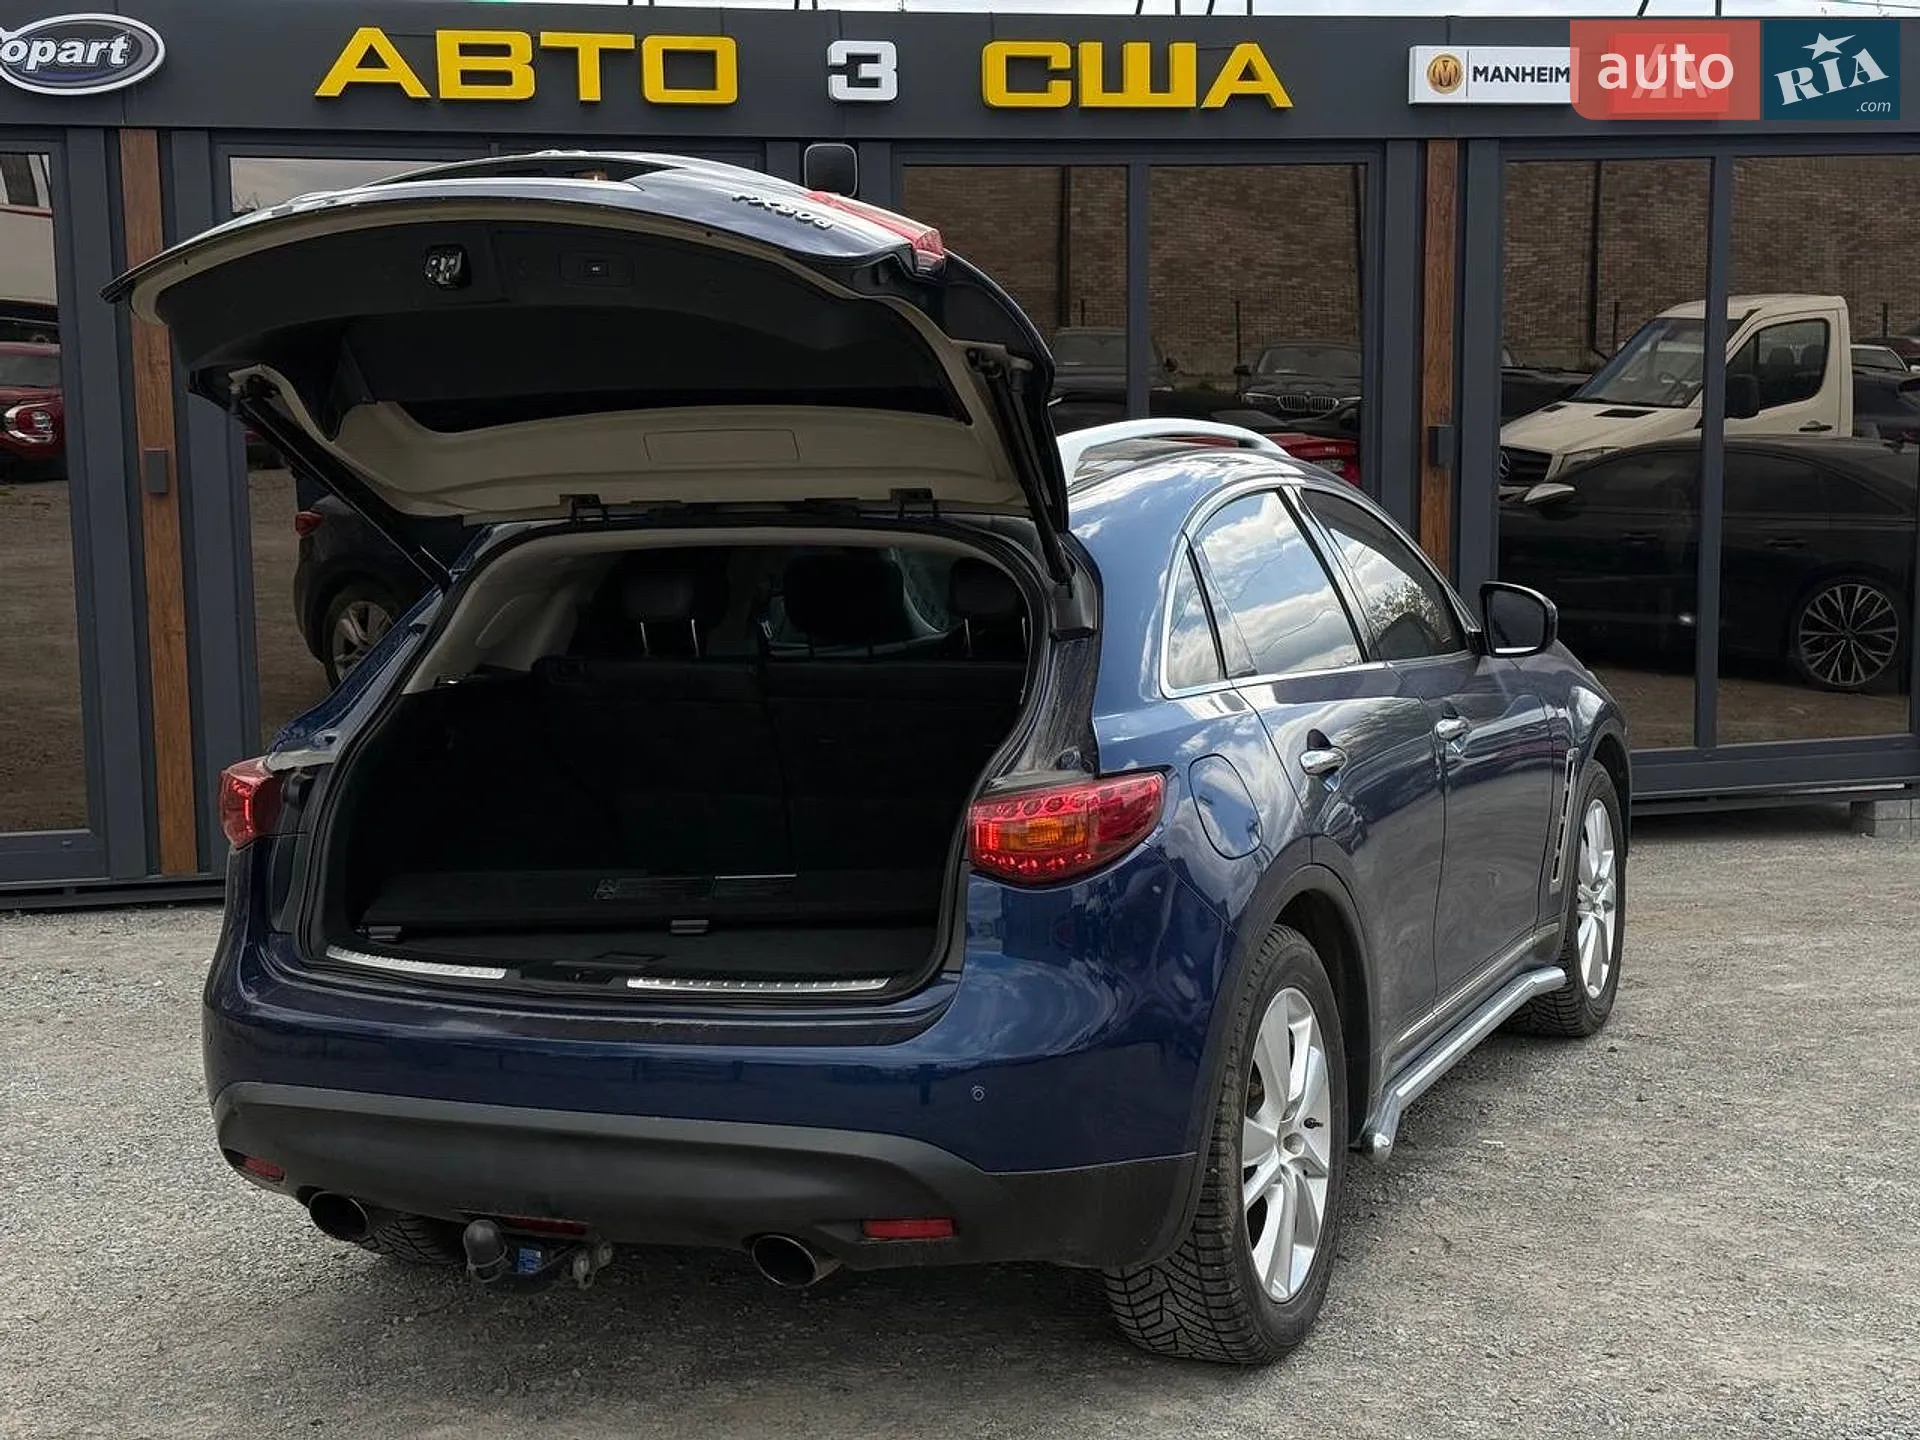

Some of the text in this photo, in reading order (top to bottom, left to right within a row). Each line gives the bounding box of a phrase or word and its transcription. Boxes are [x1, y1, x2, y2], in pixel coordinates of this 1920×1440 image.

[0, 34, 129, 71] opart
[315, 27, 740, 106] АВТО
[982, 39, 1293, 109] США
[1472, 65, 1570, 83] MANHEIM
